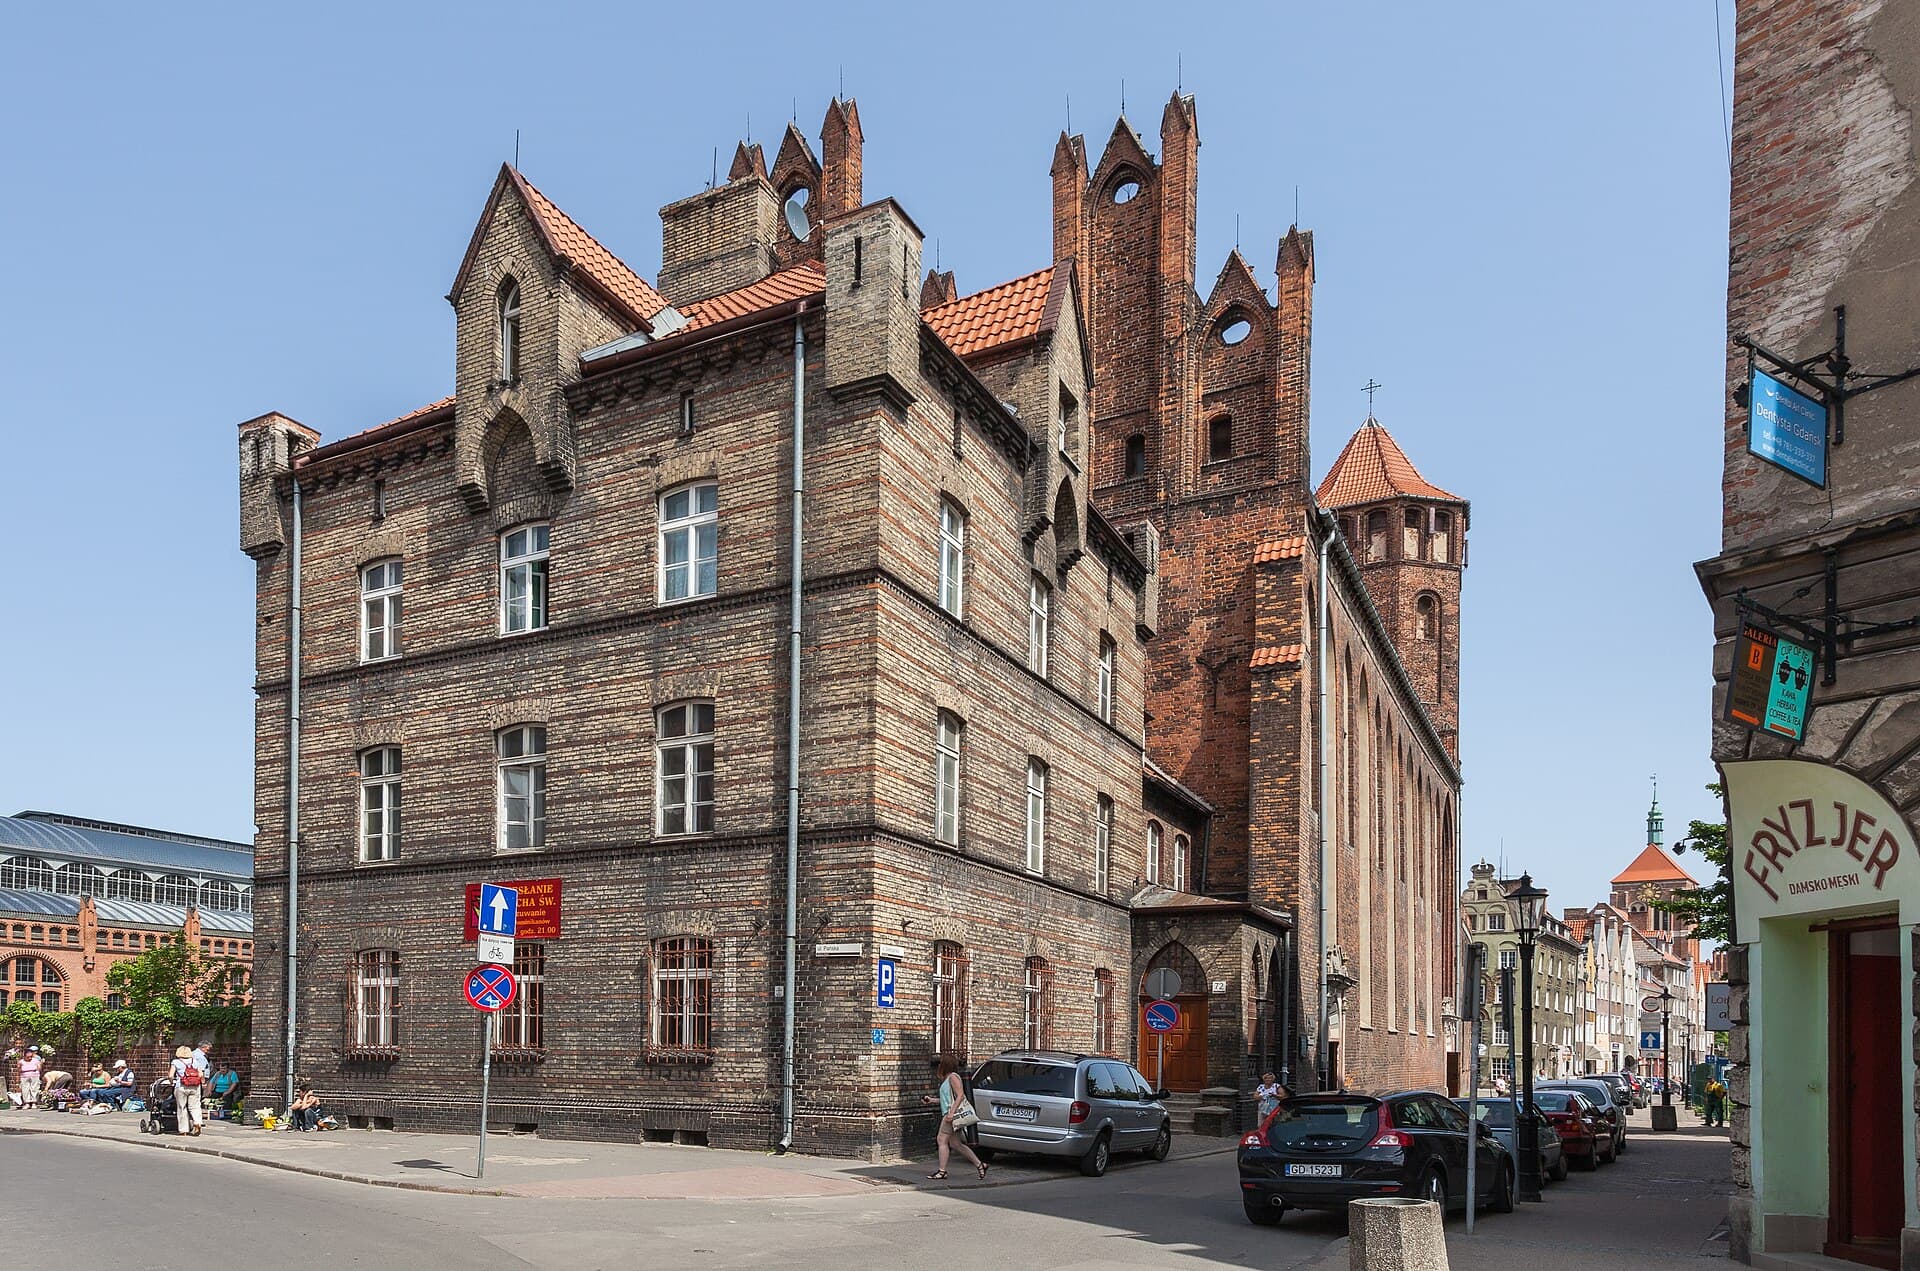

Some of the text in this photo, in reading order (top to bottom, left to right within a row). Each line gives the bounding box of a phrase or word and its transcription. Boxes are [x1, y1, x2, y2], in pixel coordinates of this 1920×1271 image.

[1756, 403, 1791, 432] Dentysta
[1752, 649, 1760, 664] B
[1769, 707, 1787, 722] COFFEE
[1743, 798, 1901, 903] FRYZJER
[513, 884, 554, 895] SŁANIE
[1789, 878, 1828, 895] DAMSKO
[517, 893, 557, 907] CHA ŚW.
[882, 964, 892, 991] P
[1214, 982, 1224, 990] 72
[1291, 1165, 1340, 1175] GD 1523T
